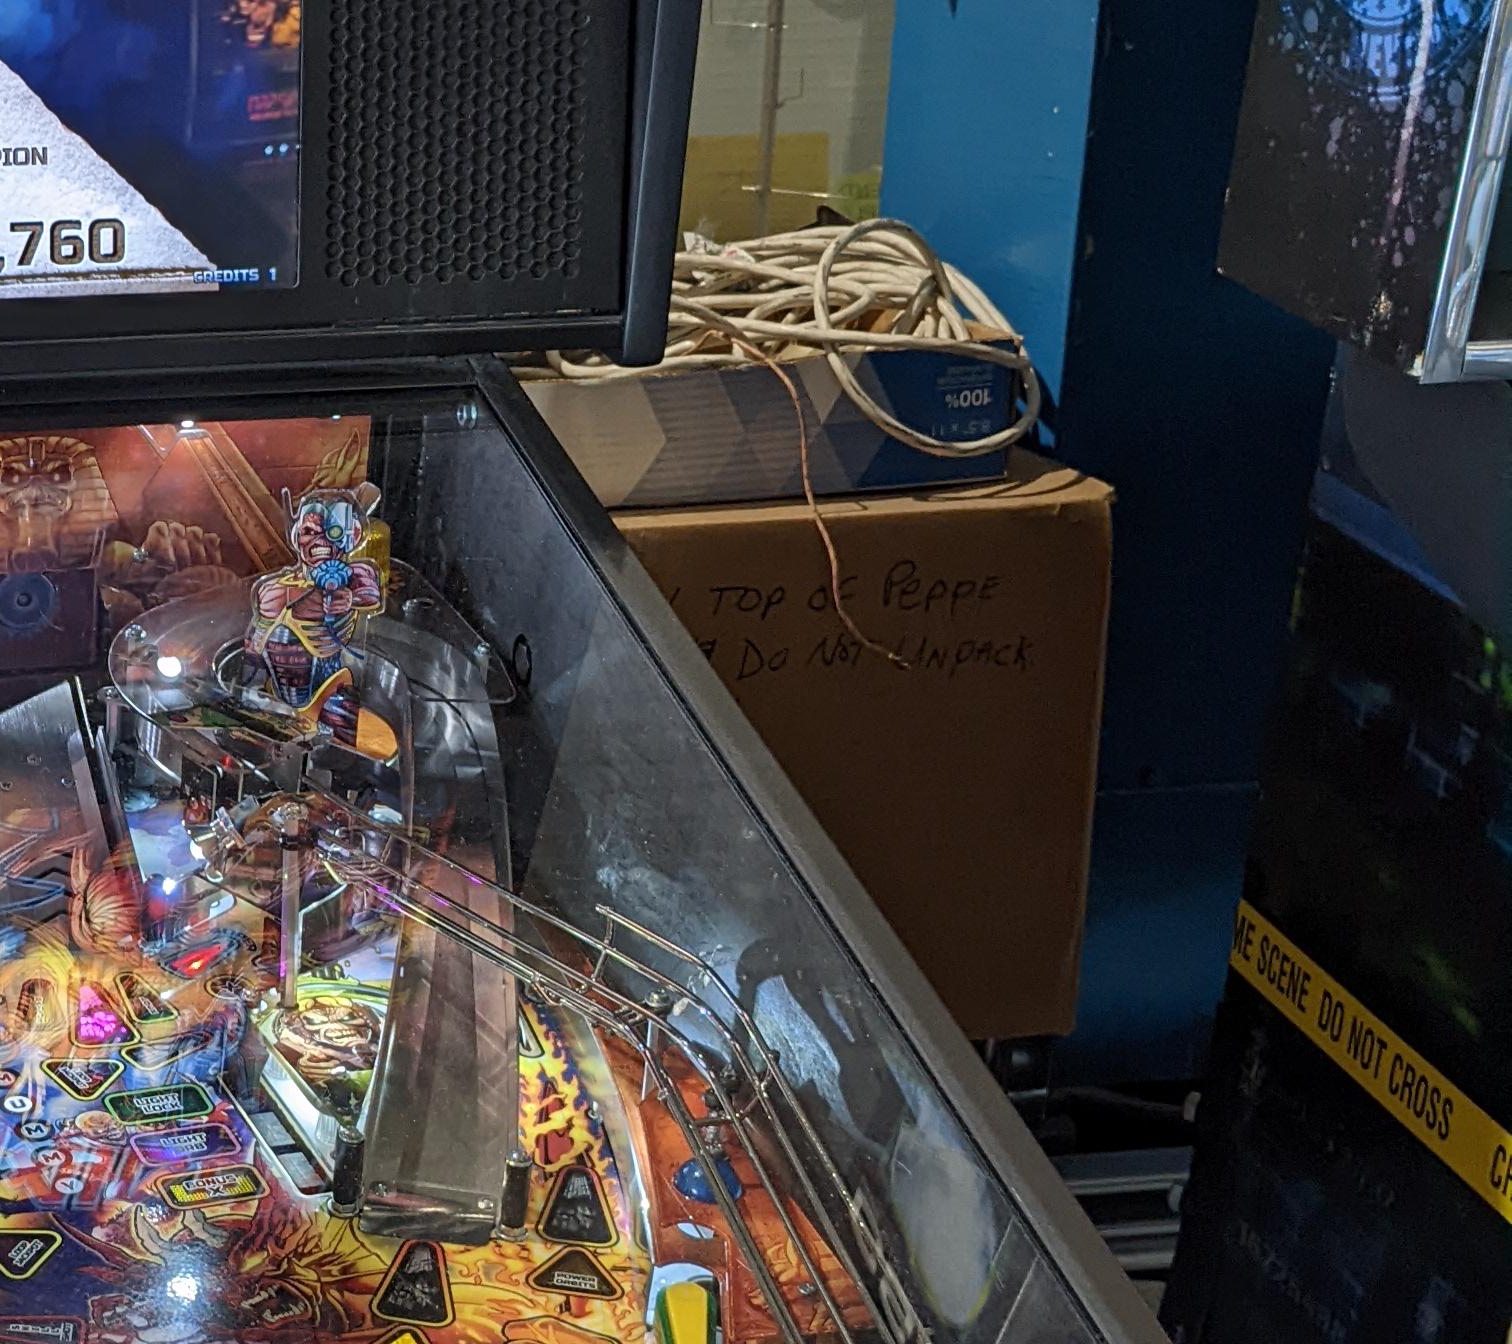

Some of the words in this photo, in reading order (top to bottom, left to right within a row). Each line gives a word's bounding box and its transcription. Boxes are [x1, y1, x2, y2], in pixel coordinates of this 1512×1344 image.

[193, 267, 260, 284] CREDITS
[269, 266, 277, 282] 1
[710, 584, 787, 621] TOP
[1256, 923, 1310, 1015] SCENE
[1317, 988, 1345, 1044] DO
[1348, 1015, 1390, 1081] NOT
[1389, 1053, 1454, 1142] CROSS
[133, 1093, 180, 1106] LIGHT
[159, 1132, 207, 1147] LIGHT
[183, 1174, 238, 1190] BONUS
[554, 1272, 597, 1284] POWER
[554, 1278, 598, 1290] ORBITS
